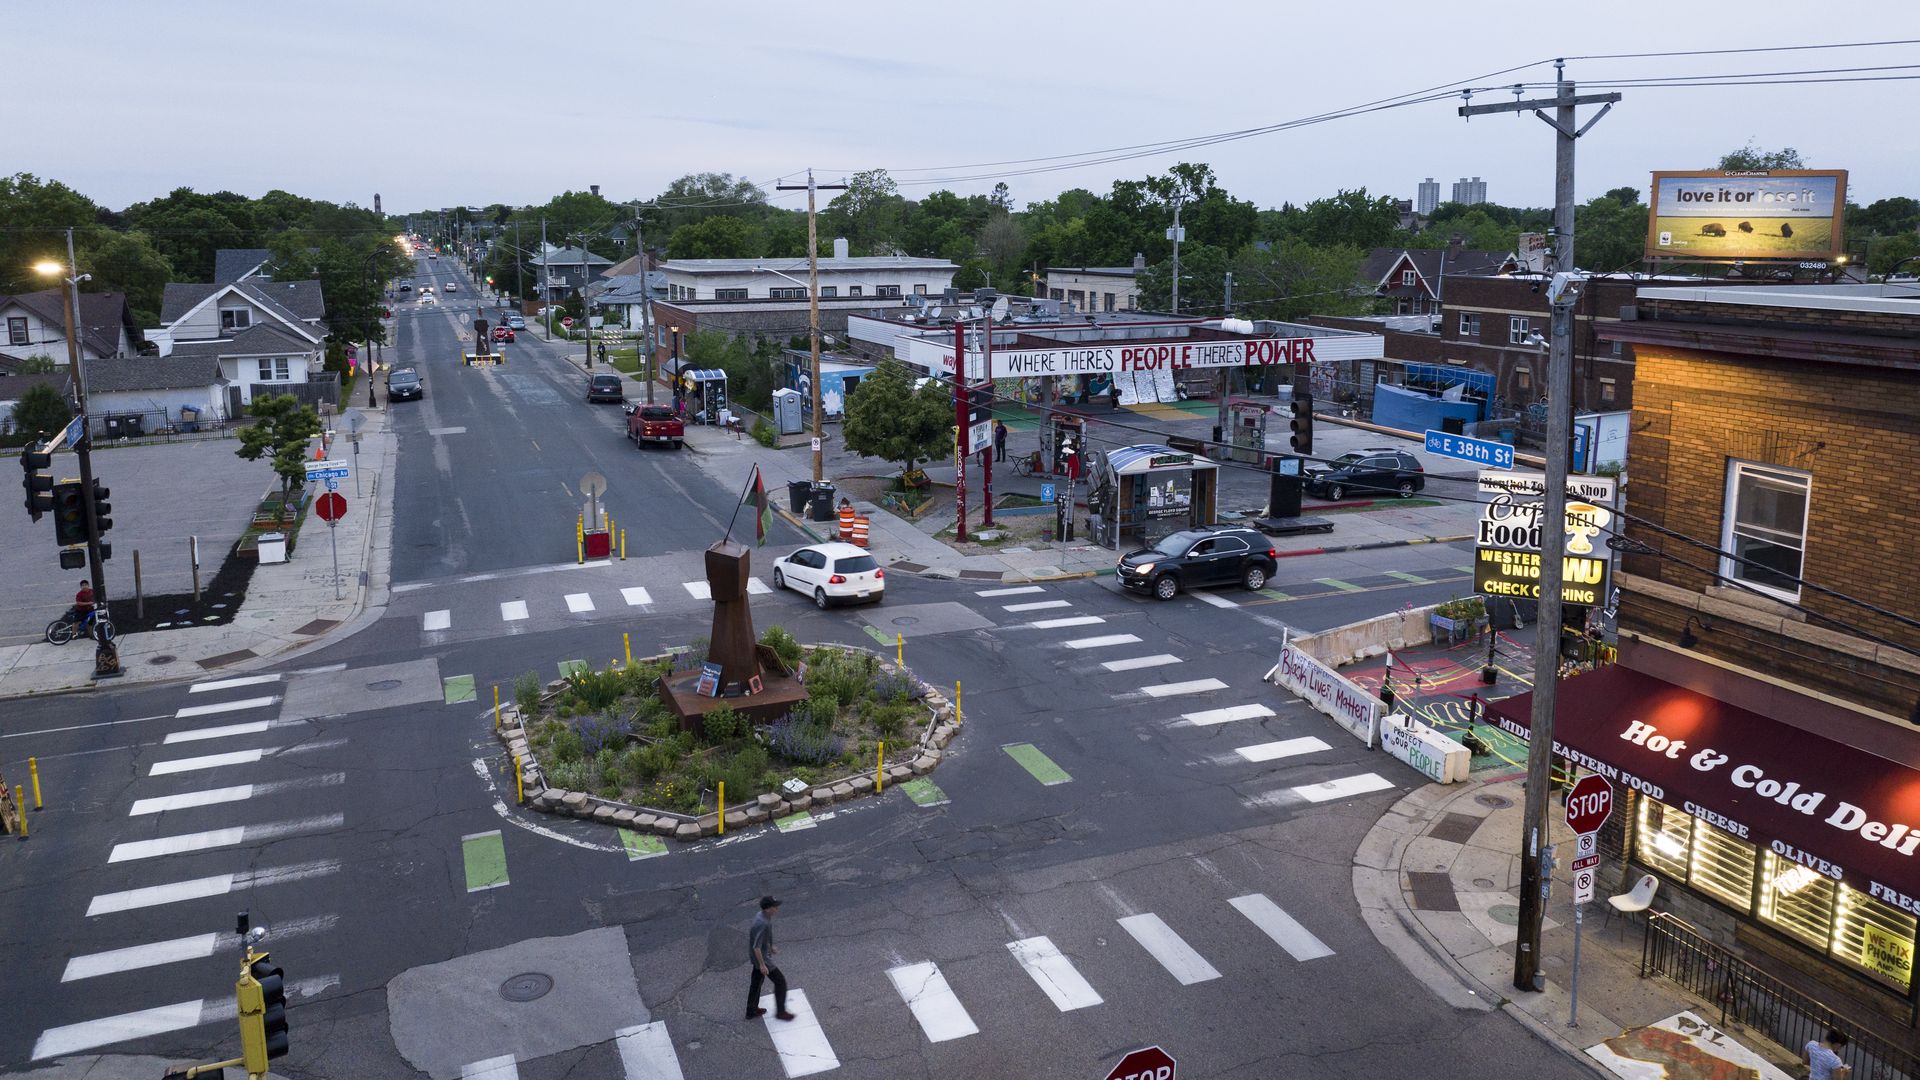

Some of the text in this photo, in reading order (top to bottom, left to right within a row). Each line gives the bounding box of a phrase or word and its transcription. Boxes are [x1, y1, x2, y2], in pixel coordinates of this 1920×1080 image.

[1677, 188, 1816, 203] love it or lose it
[1009, 352, 1056, 372] WHERE
[1121, 346, 1192, 372] PEOPLE
[1245, 338, 1317, 366] POWER
[1443, 438, 1510, 464] E 38th St
[315, 471, 338, 479] Chicago
[1483, 477, 1528, 491] Menthol
[1580, 483, 1607, 498] Shop
[1568, 512, 1595, 527] DELI
[1480, 520, 1542, 547] Food
[1480, 550, 1540, 566] WESTER
[1501, 563, 1540, 578] UNIO
[1562, 557, 1603, 584] WU
[1483, 580, 1530, 597] CHECK
[1532, 585, 1595, 603] CHING
[1281, 648, 1307, 687] Black
[1393, 726, 1423, 748] PROTECT
[1396, 737, 1409, 751] OUR
[1410, 746, 1441, 780] PEOPLE
[1500, 717, 1531, 741] MIDD
[1552, 741, 1619, 780] EASTERN
[1621, 773, 1664, 800] FOOD
[1684, 800, 1749, 840] CHEESE
[1771, 839, 1844, 881] OLIVES
[1619, 719, 1920, 856] Hot & Cold Deli
[1568, 790, 1610, 820] STOP
[1573, 856, 1598, 870] ALL WAY
[1866, 943, 1910, 971] PHONES
[1869, 931, 1910, 959] WE FIX
[1876, 961, 1894, 972] AND
